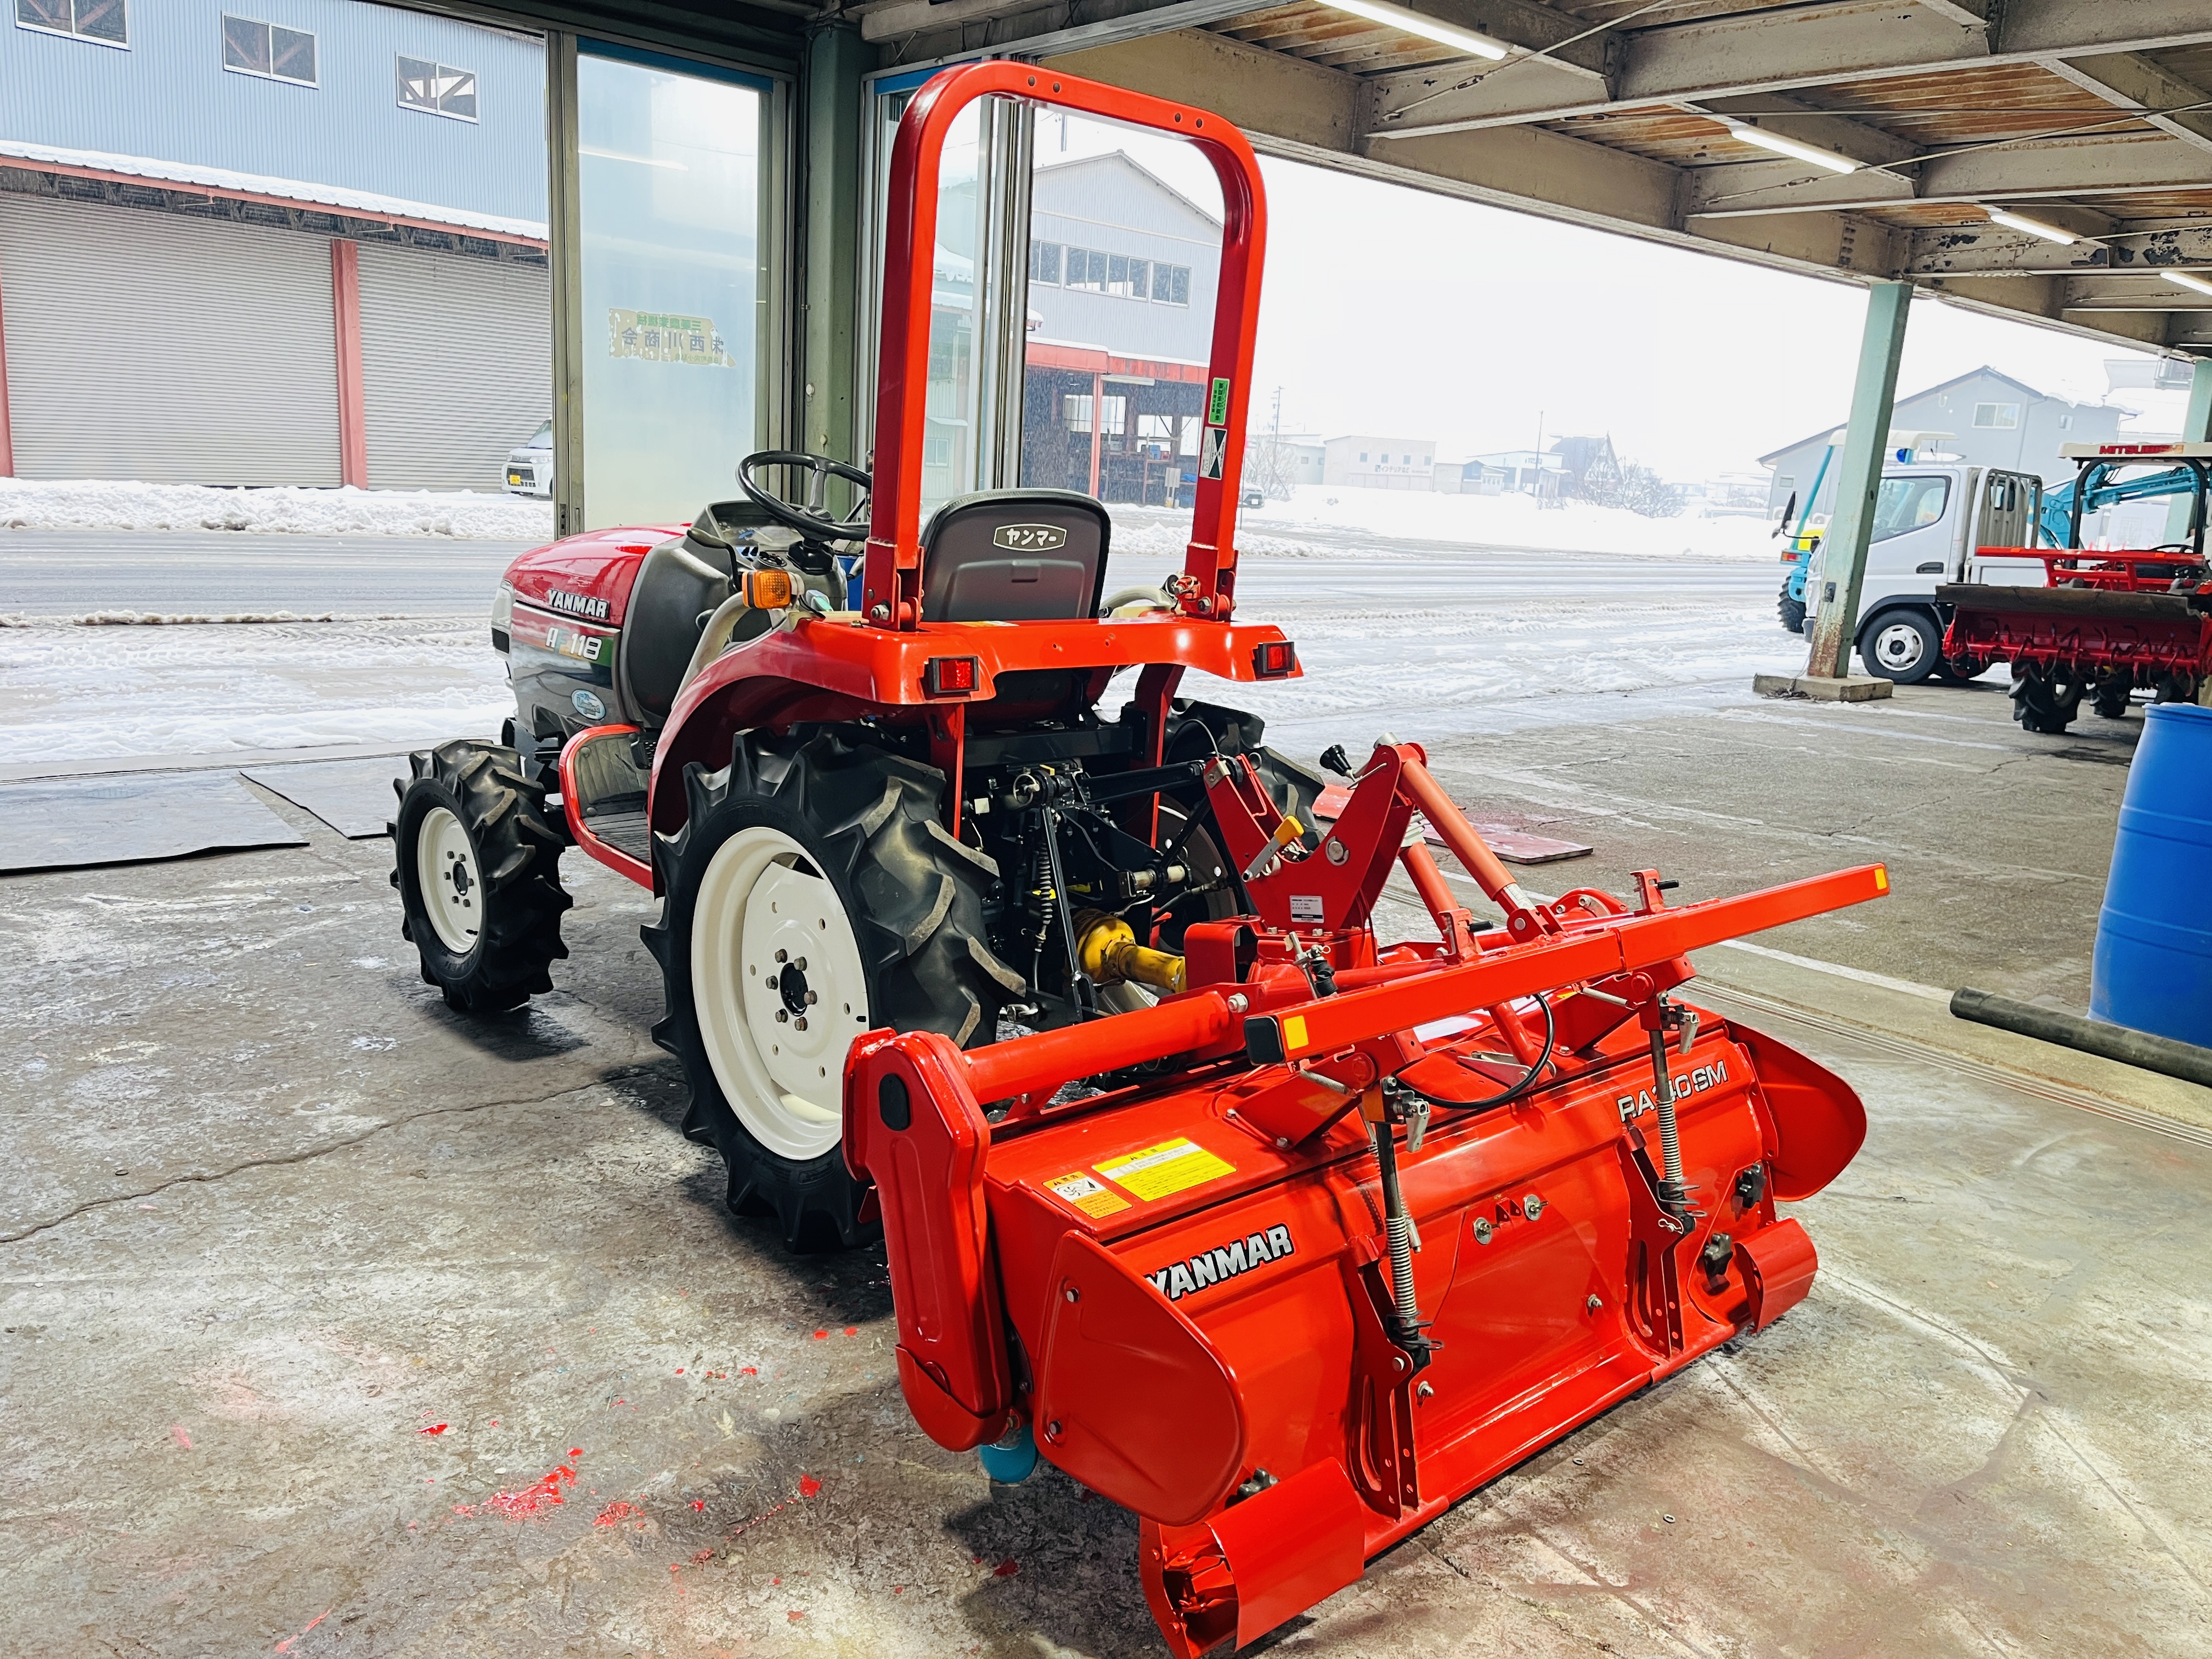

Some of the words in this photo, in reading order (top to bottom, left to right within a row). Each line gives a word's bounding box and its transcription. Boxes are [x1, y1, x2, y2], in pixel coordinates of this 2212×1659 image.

[1006, 528, 1057, 546] ヤンマー
[548, 589, 610, 619] YANMAR
[545, 627, 602, 661] AF118
[1617, 1059, 1728, 1122] RA40SM
[1144, 1223, 1295, 1300] YANMAR
